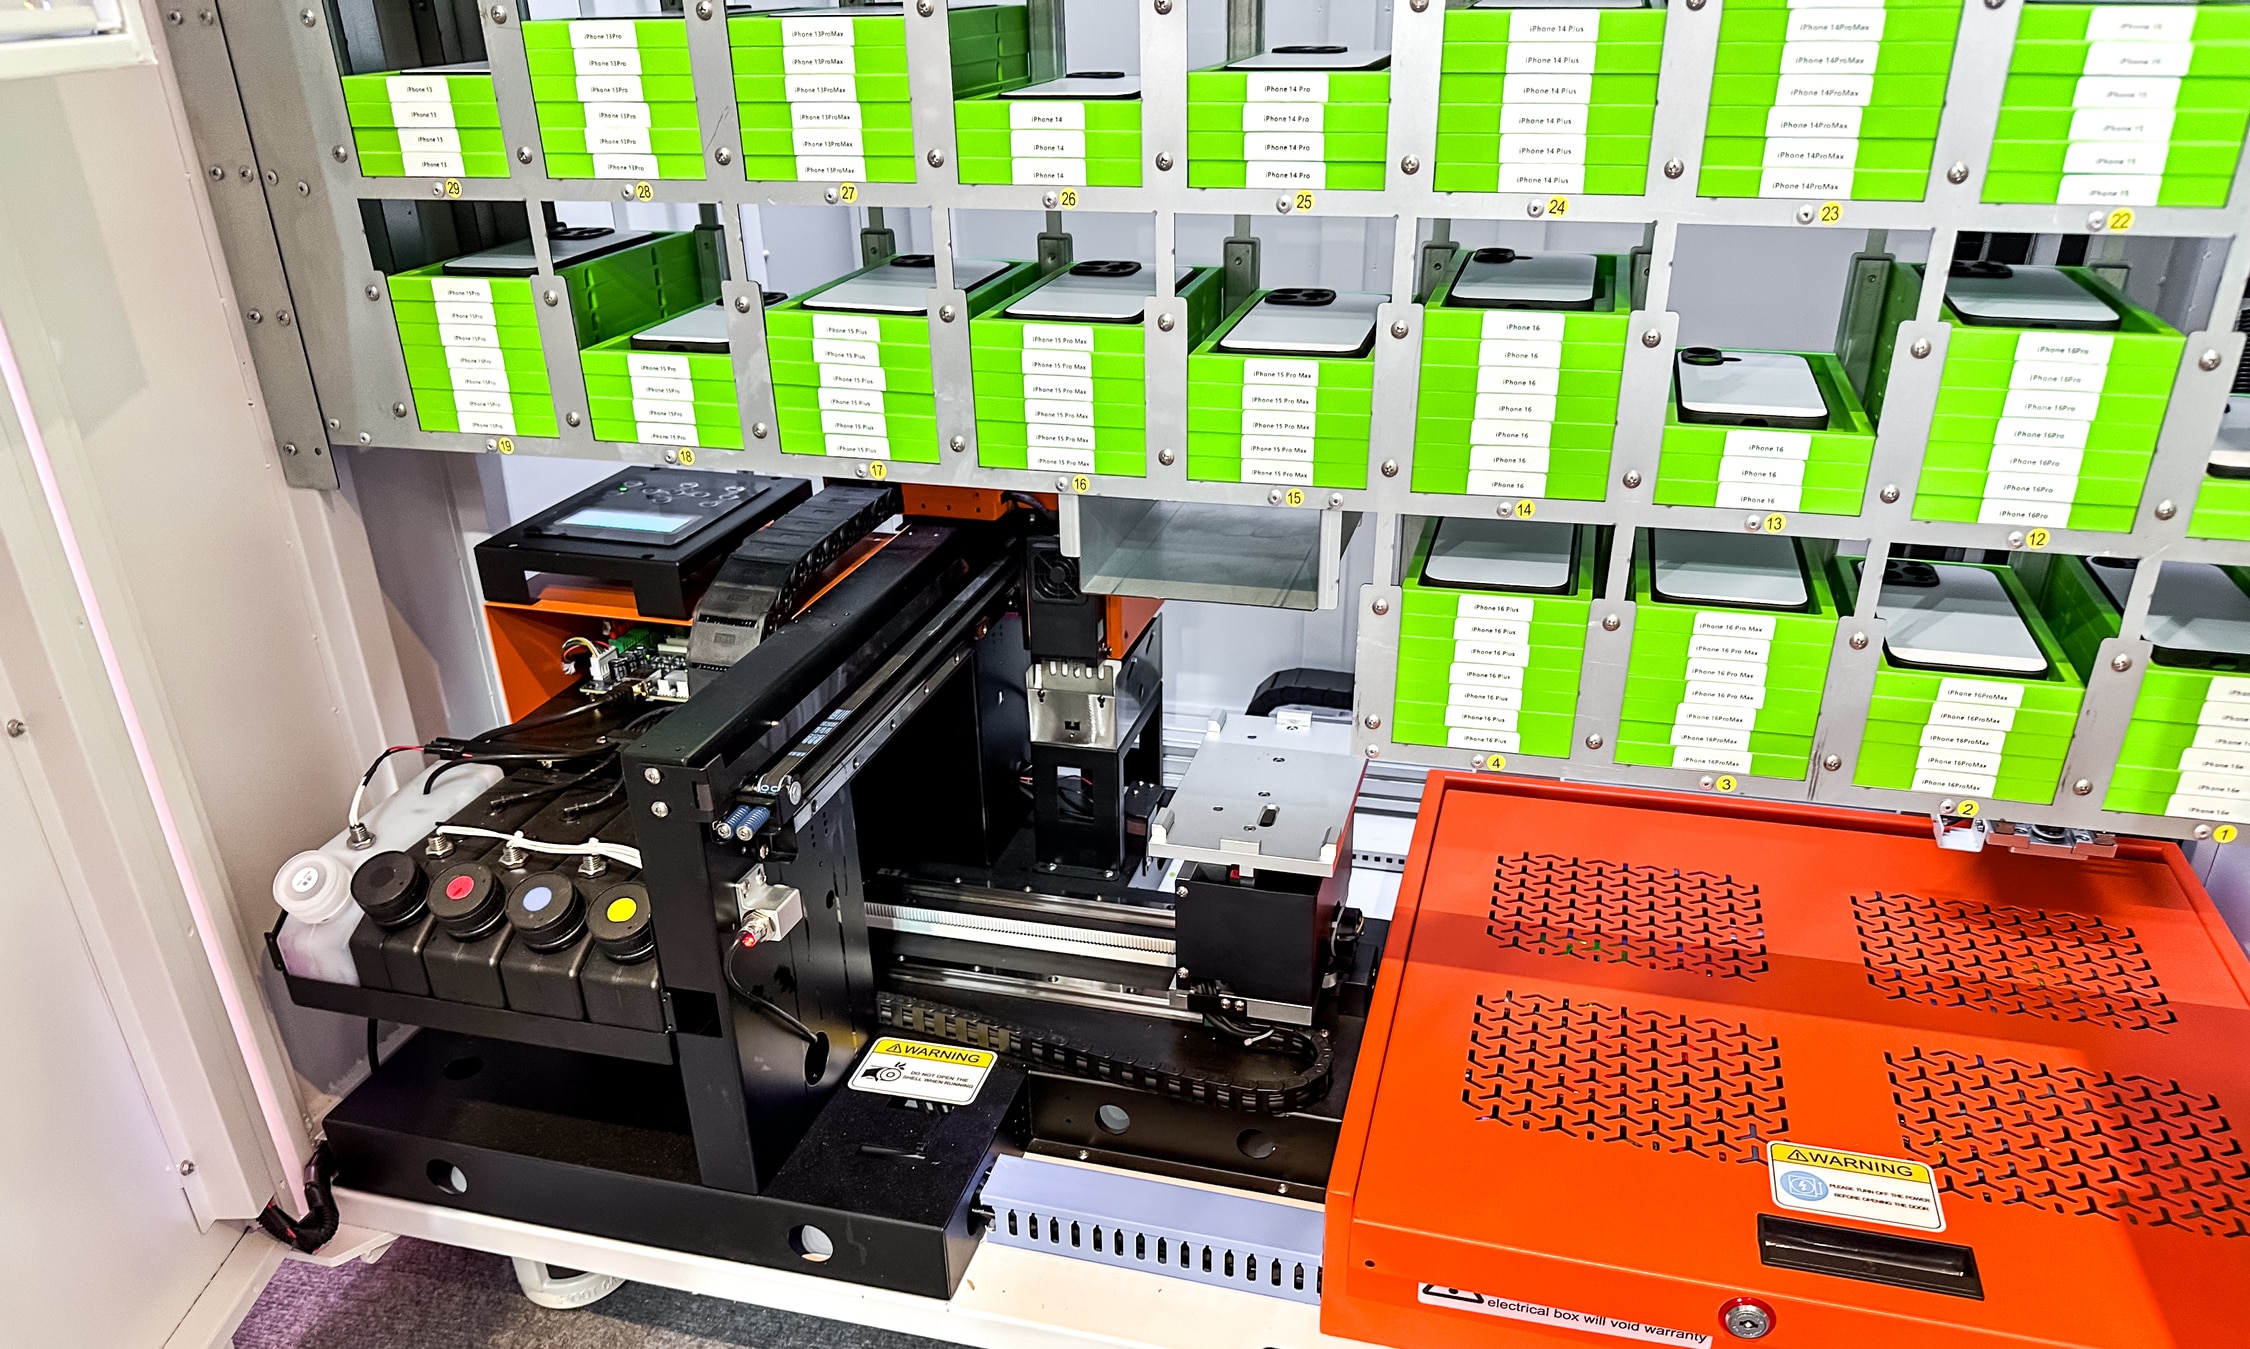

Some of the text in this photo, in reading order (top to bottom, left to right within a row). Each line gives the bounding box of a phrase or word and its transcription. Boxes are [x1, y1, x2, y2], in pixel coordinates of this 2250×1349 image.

[448, 182, 460, 194] 29
[638, 185, 651, 198] 28
[842, 186, 854, 199] 27
[1062, 192, 1075, 206] 26
[1297, 195, 1311, 209] 25
[1549, 200, 1564, 214] 24
[1822, 206, 1838, 221] 23
[2110, 213, 2130, 228] 22
[501, 440, 511, 452] 19
[681, 451, 692, 462] 18
[872, 465, 882, 475] 17
[1075, 478, 1086, 490] 16
[1288, 492, 1300, 504] 15
[1518, 504, 1531, 516] 14
[1768, 518, 1781, 530] 13
[2030, 533, 2046, 545] 12
[1974, 692, 2008, 701] 16ProMax
[1492, 758, 1500, 768] 4
[1722, 779, 1730, 790] 3
[1948, 782, 1980, 791] 16ProMax
[1962, 804, 1973, 815] 2
[2223, 830, 2228, 840] 1
[905, 1045, 980, 1063] WARNING
[1809, 1152, 1913, 1176] WARNING
[1862, 1197, 1892, 1205] OPENING
[1487, 1299, 1707, 1344] electrical box will void warranty
